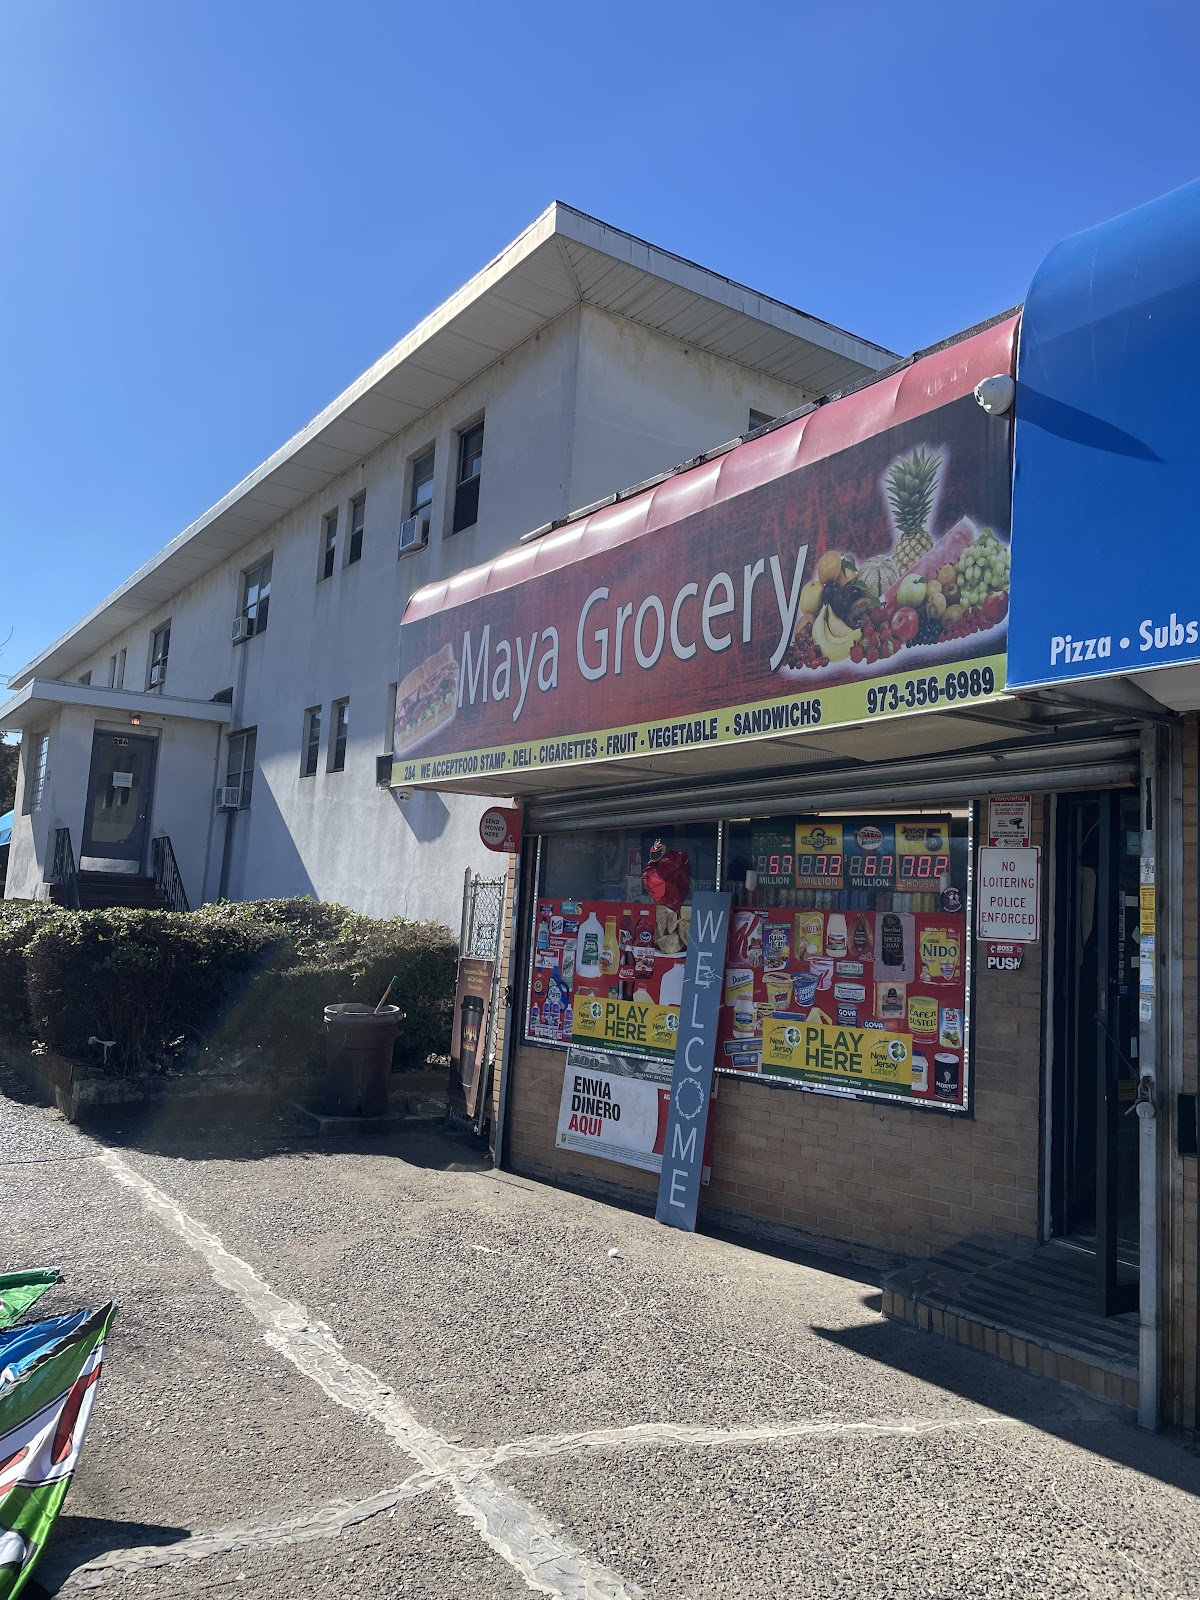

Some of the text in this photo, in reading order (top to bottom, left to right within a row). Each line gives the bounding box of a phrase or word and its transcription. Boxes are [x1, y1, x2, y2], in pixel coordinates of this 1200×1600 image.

[458, 544, 809, 722] Maya Grocery
[1050, 612, 1199, 666] Pizza Subs
[867, 666, 995, 714] 973-356-6989
[113, 738, 128, 746] 286
[404, 765, 416, 781] 284
[420, 762, 431, 779] WE
[480, 751, 506, 771] STAMP
[512, 747, 531, 767] DELI
[539, 737, 598, 764] CIGARETTES
[606, 731, 638, 755] FRUIT
[647, 717, 718, 749] VEGETABLE
[733, 698, 822, 736] SANDWICHS
[901, 826, 926, 834] Jersey
[1002, 862, 1016, 872] NO
[759, 877, 790, 885] MILLION
[803, 877, 838, 885] MILLION
[852, 878, 889, 887] MILLION
[902, 879, 941, 888] THOUSAN
[983, 877, 1035, 889] LOITERING
[990, 896, 1026, 908] POLICE
[981, 912, 1035, 924] ENFORCED
[923, 943, 957, 957] NIDO
[988, 957, 1022, 970] PUSH
[606, 1003, 649, 1024] PLAY
[838, 1009, 857, 1017] GOYA
[946, 1012, 957, 1022] Dole
[578, 1024, 595, 1032] Lottery
[864, 1021, 884, 1029] GOYA
[605, 1020, 647, 1042] HERE
[655, 1030, 672, 1039] Jersey
[652, 1036, 672, 1045] Lottery
[769, 1037, 784, 1046] New
[806, 1027, 864, 1052] PLAY
[772, 1045, 794, 1054] Jersey
[769, 1051, 793, 1062] Lottery
[805, 1047, 863, 1074] HERE
[870, 1052, 888, 1061] New
[874, 1059, 898, 1070] Jersey
[870, 1066, 898, 1078] Lottery
[574, 1076, 612, 1100] ENVÍA
[936, 1081, 957, 1089] MORTON
[571, 1094, 621, 1122] DINERO
[568, 1114, 603, 1137] AQUÍ
